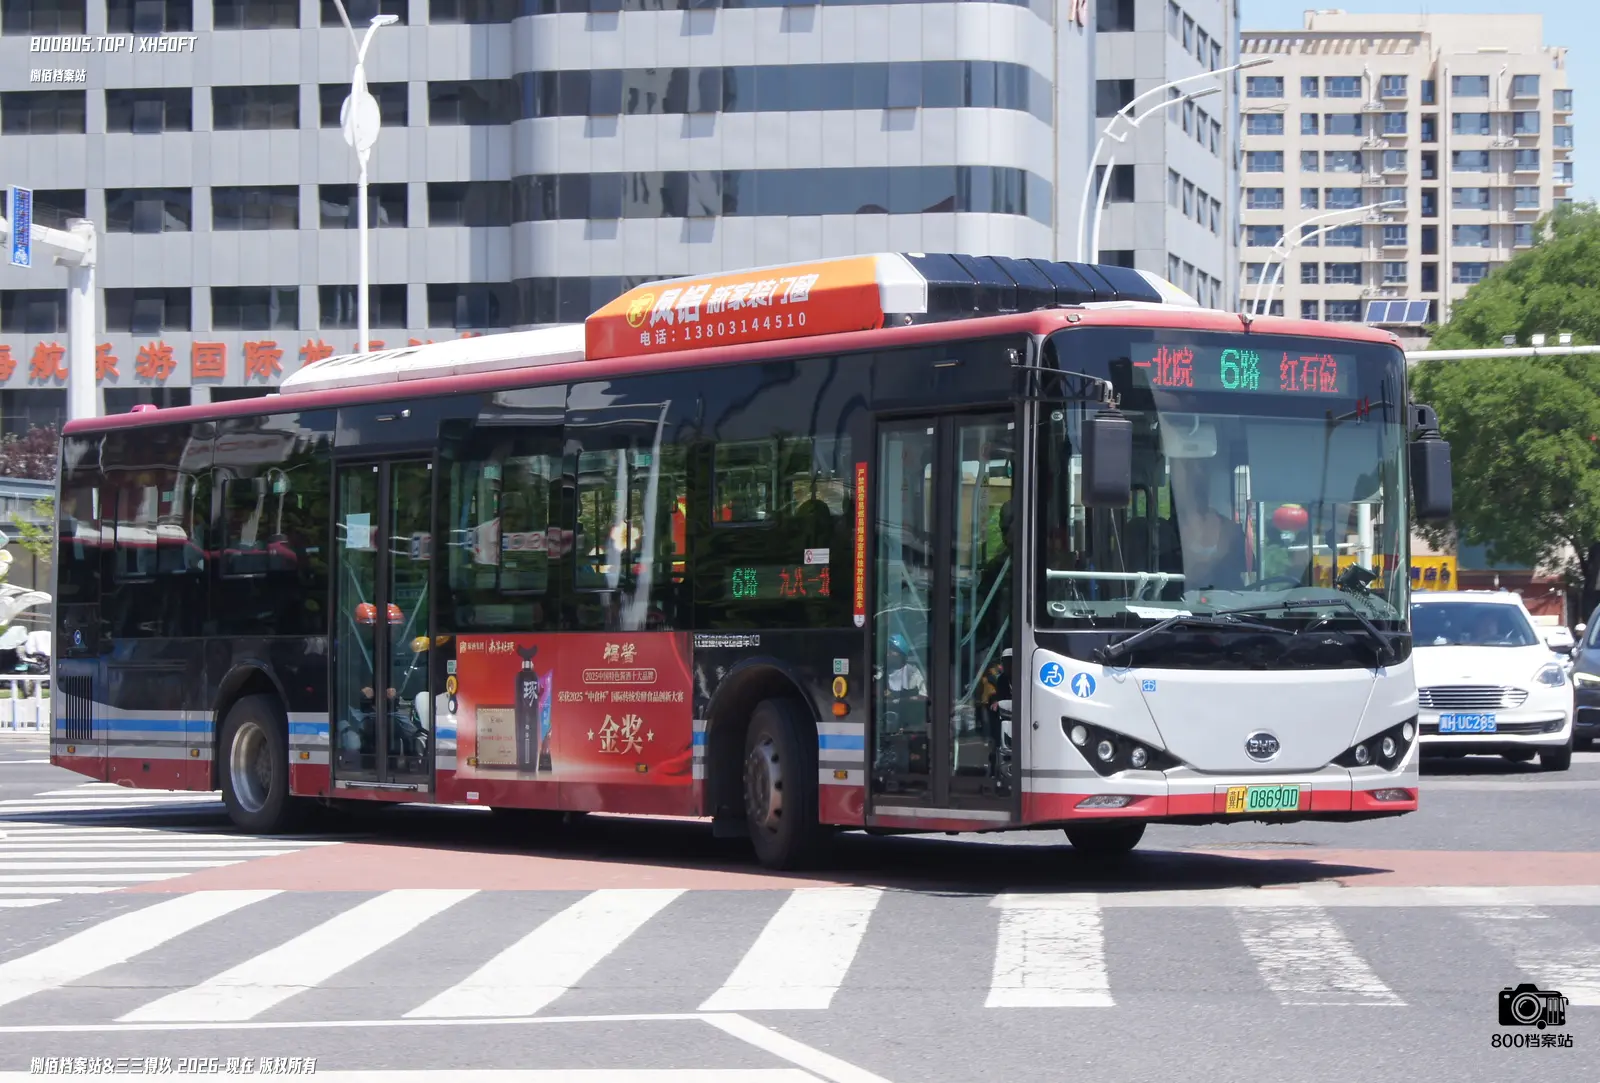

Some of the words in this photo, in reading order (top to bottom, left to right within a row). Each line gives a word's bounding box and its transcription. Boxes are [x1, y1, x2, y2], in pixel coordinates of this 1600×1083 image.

[705, 274, 819, 315] 新家装门窗
[1220, 349, 1261, 390] 6路
[732, 567, 759, 598] 6路
[598, 714, 643, 754] 金奖
[1249, 739, 1277, 753] BYD
